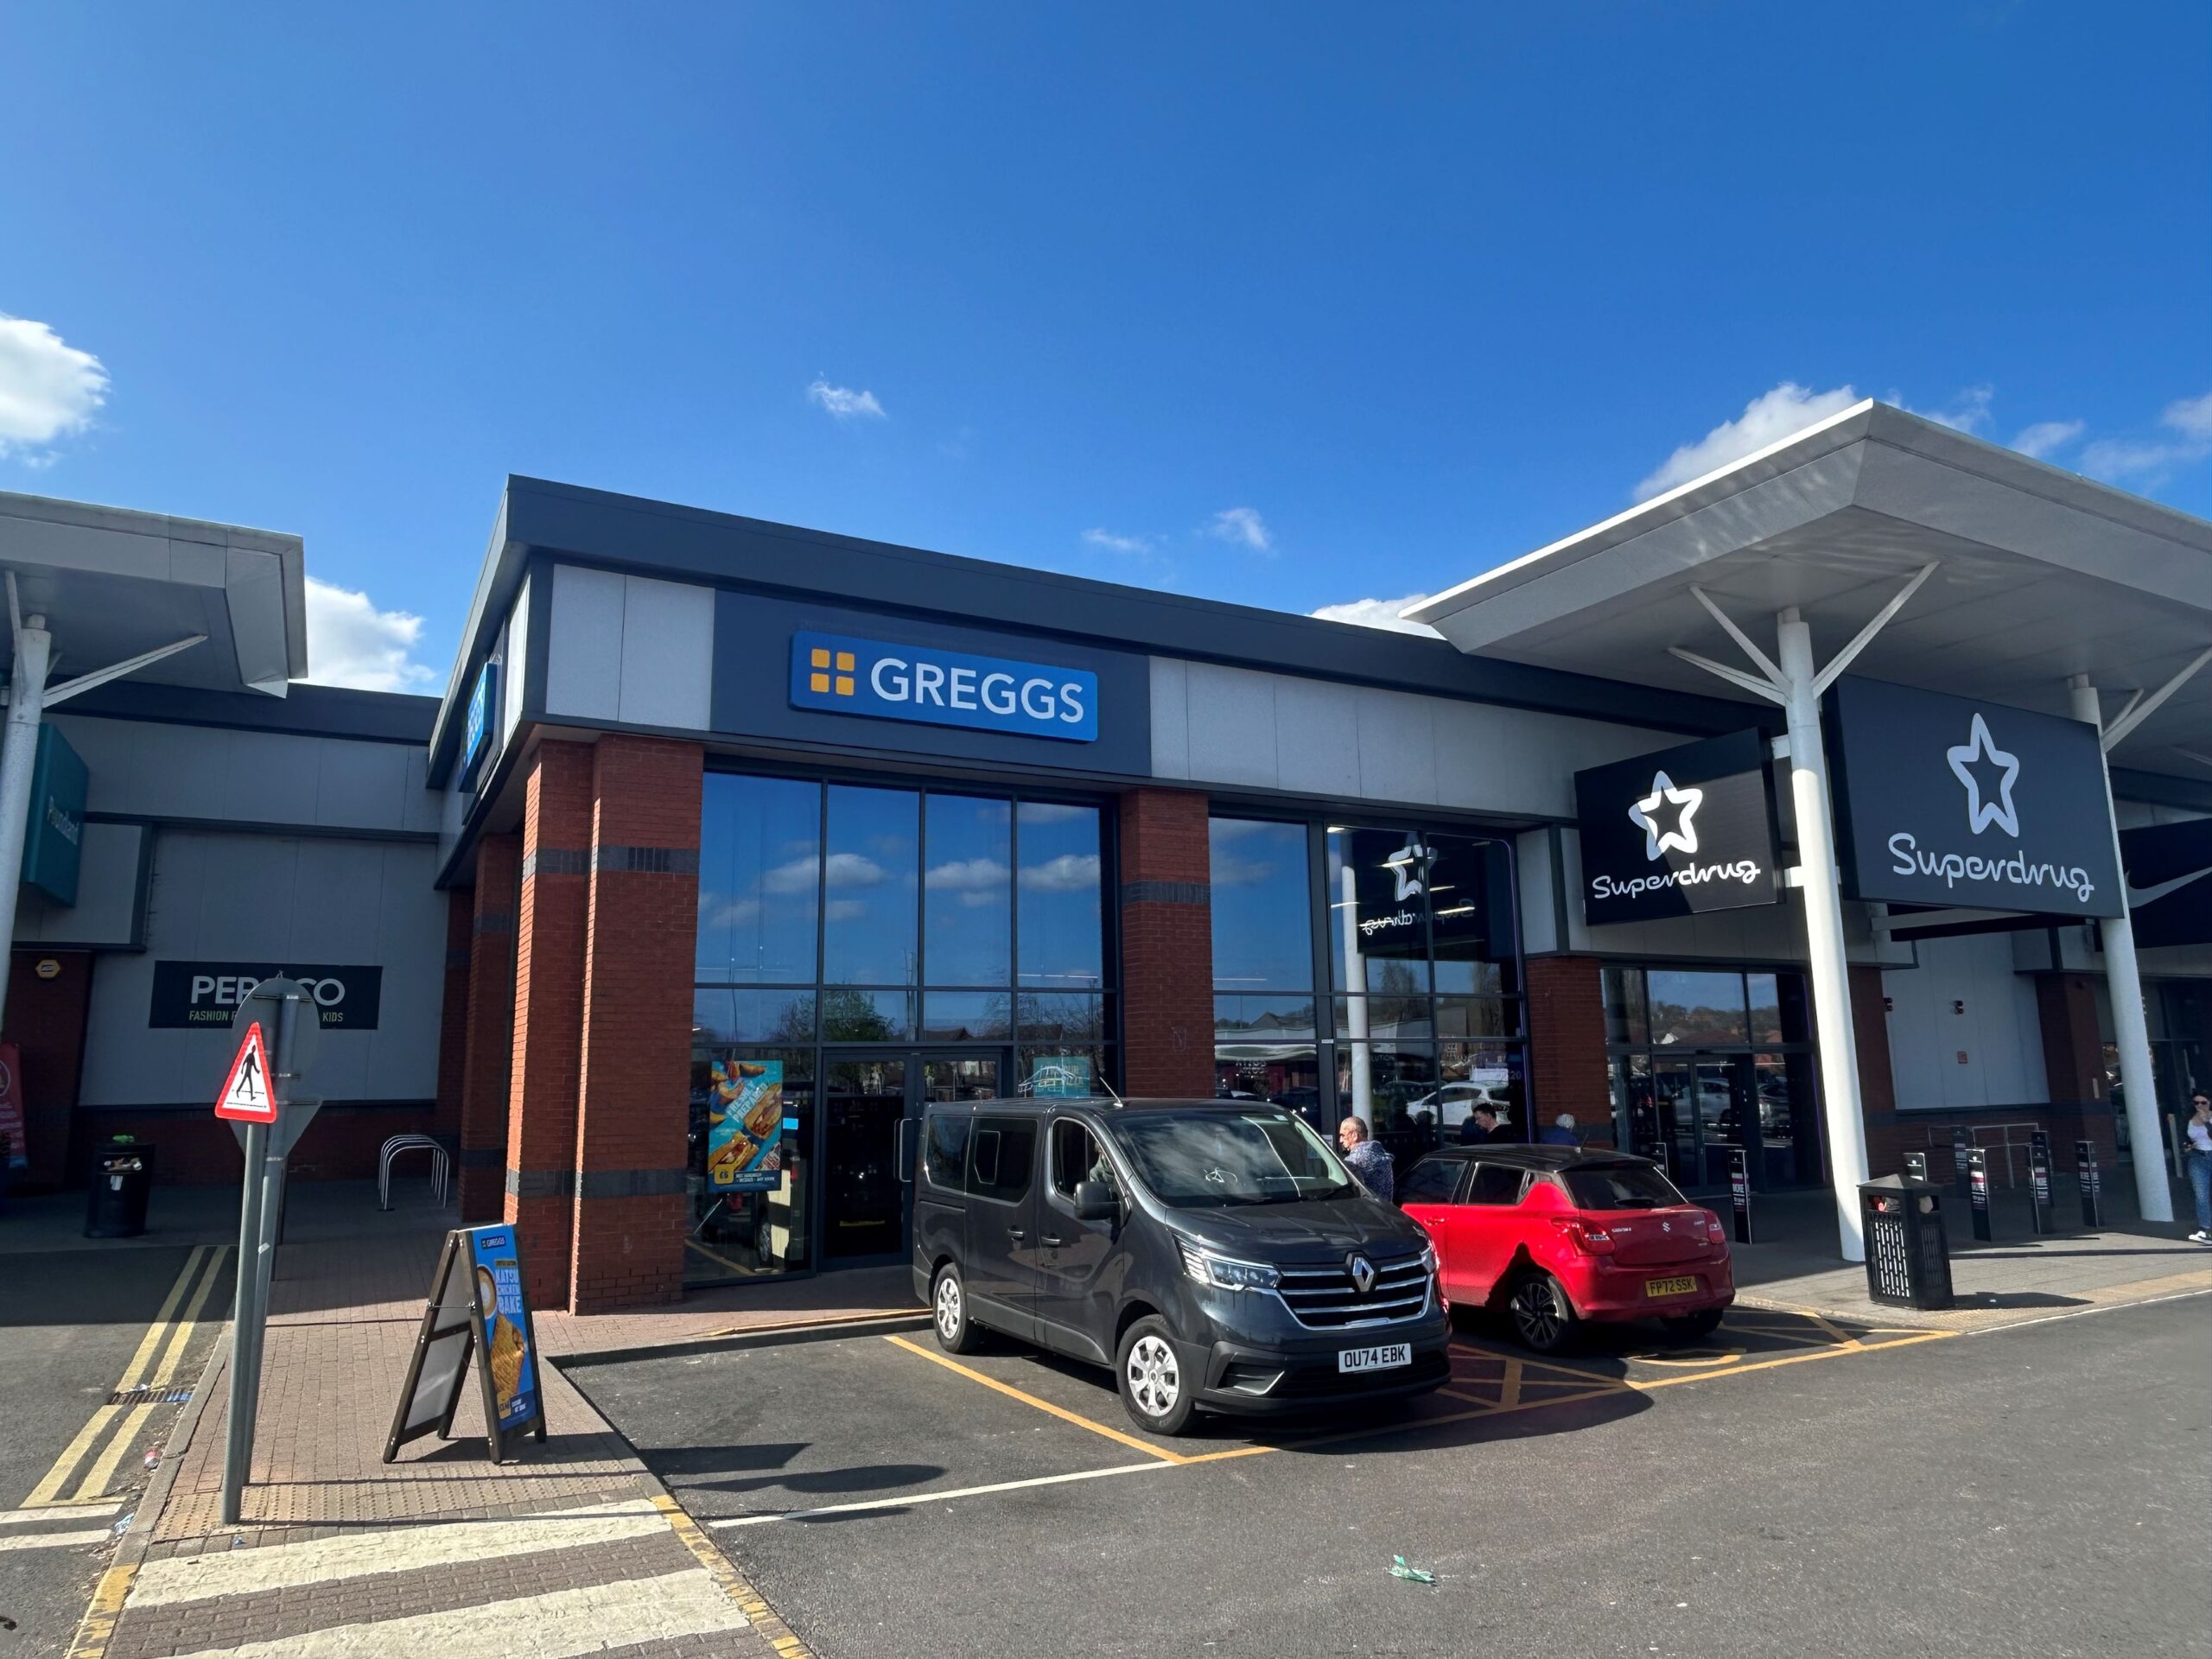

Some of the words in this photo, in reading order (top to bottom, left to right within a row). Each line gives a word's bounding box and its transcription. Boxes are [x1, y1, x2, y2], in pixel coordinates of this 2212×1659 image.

[871, 658, 1084, 723] GREGGS
[1888, 832, 2094, 902] Superdrug
[1592, 860, 1761, 899] Superdrug
[190, 976, 346, 1006] PEPO
[188, 1010, 229, 1021] FASHION
[322, 1012, 344, 1022] KIDS
[495, 1268, 519, 1284] KATSU
[1649, 1280, 1675, 1294] FP72
[1676, 1278, 1694, 1293] SSK
[498, 1296, 523, 1314] BAKE
[1344, 1349, 1378, 1368] OU74
[1382, 1345, 1406, 1363] EBK
